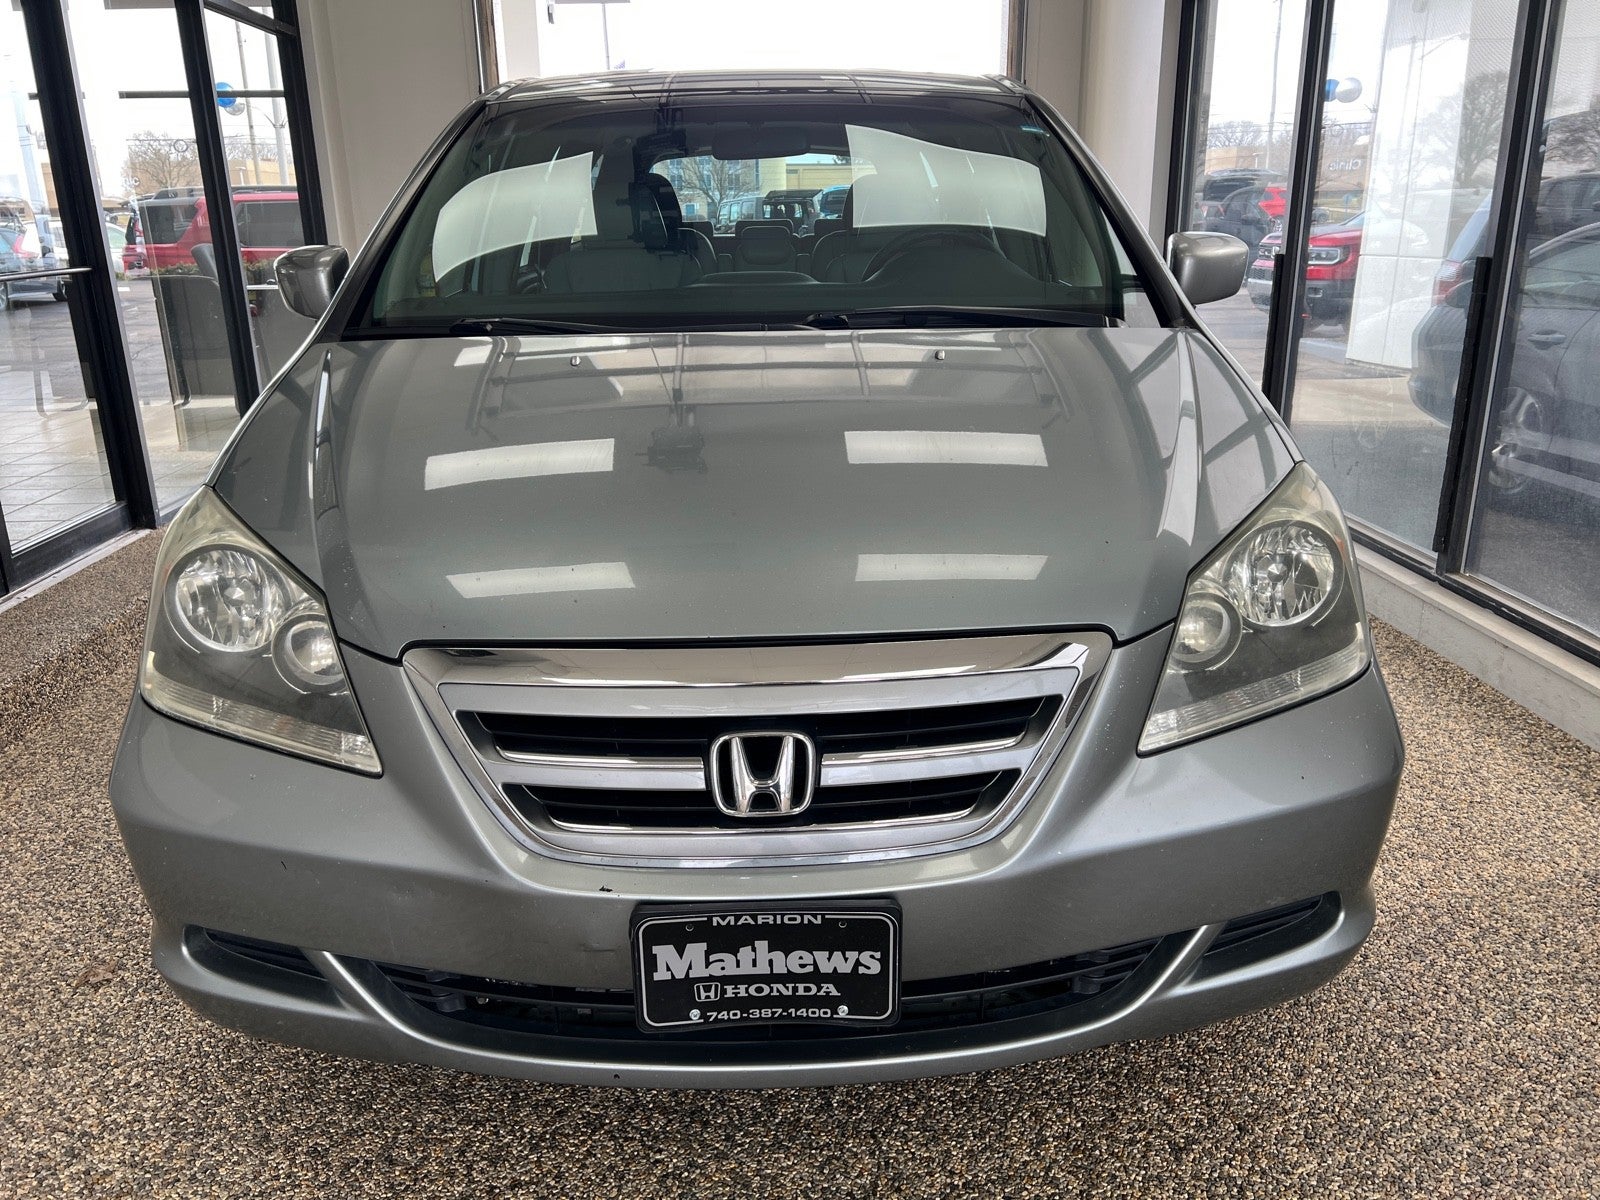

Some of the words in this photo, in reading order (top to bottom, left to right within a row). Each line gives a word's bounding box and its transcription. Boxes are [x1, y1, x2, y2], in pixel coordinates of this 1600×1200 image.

[711, 914, 823, 927] MARION
[651, 940, 882, 982] Mathews
[723, 983, 842, 998] HONDA
[706, 1008, 832, 1022] 740-387-1400
